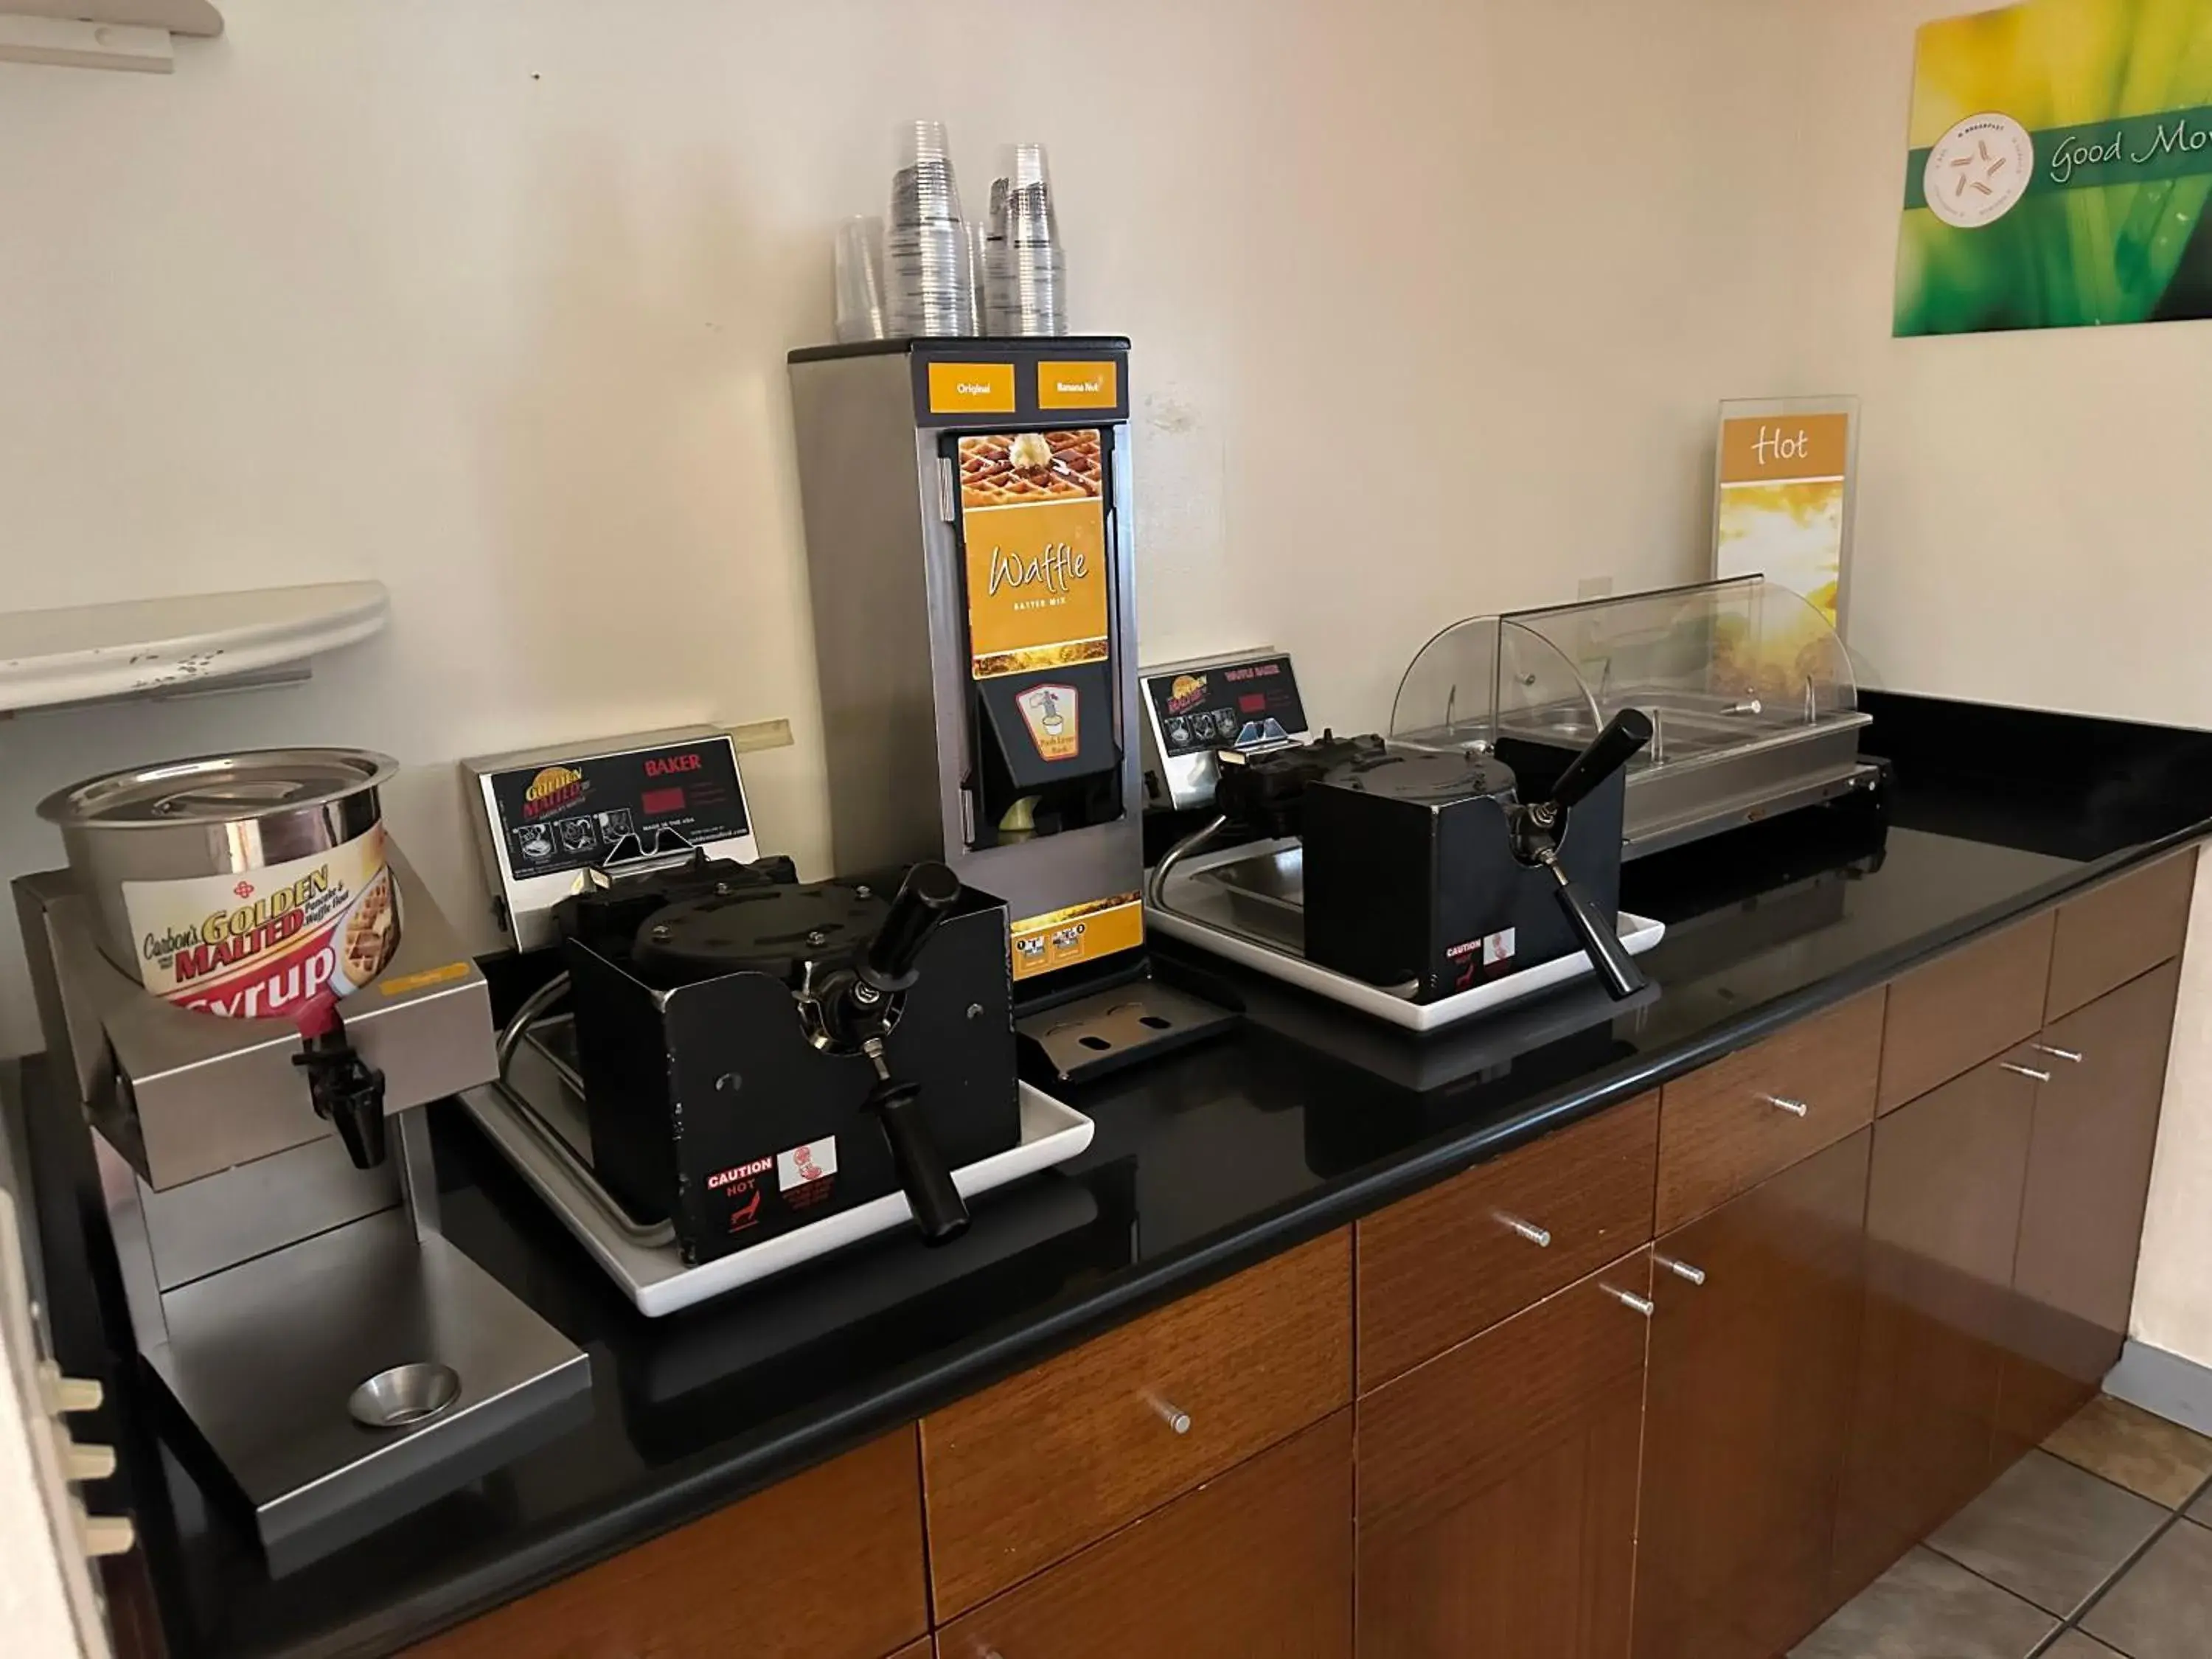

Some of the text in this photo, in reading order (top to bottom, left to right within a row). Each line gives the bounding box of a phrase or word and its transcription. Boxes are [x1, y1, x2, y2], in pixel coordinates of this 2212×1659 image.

[2051, 131, 2122, 183] Good
[2130, 119, 2212, 163] Mo
[956, 382, 991, 395] Original
[1057, 382, 1099, 392] Banana Nut
[1750, 425, 1809, 465] Hot
[989, 542, 1088, 595] Waffle
[1013, 597, 1066, 611] BATTER MIX
[644, 754, 702, 778] BAKER
[144, 864, 328, 960] Carbon's GOLDEN
[305, 888, 337, 914] Pancake
[175, 908, 304, 983] MALTED
[1446, 939, 1481, 957] CAUTION
[185, 947, 333, 1020] yrup
[708, 1157, 773, 1188] CAUTION
[727, 1179, 755, 1197] HOT
